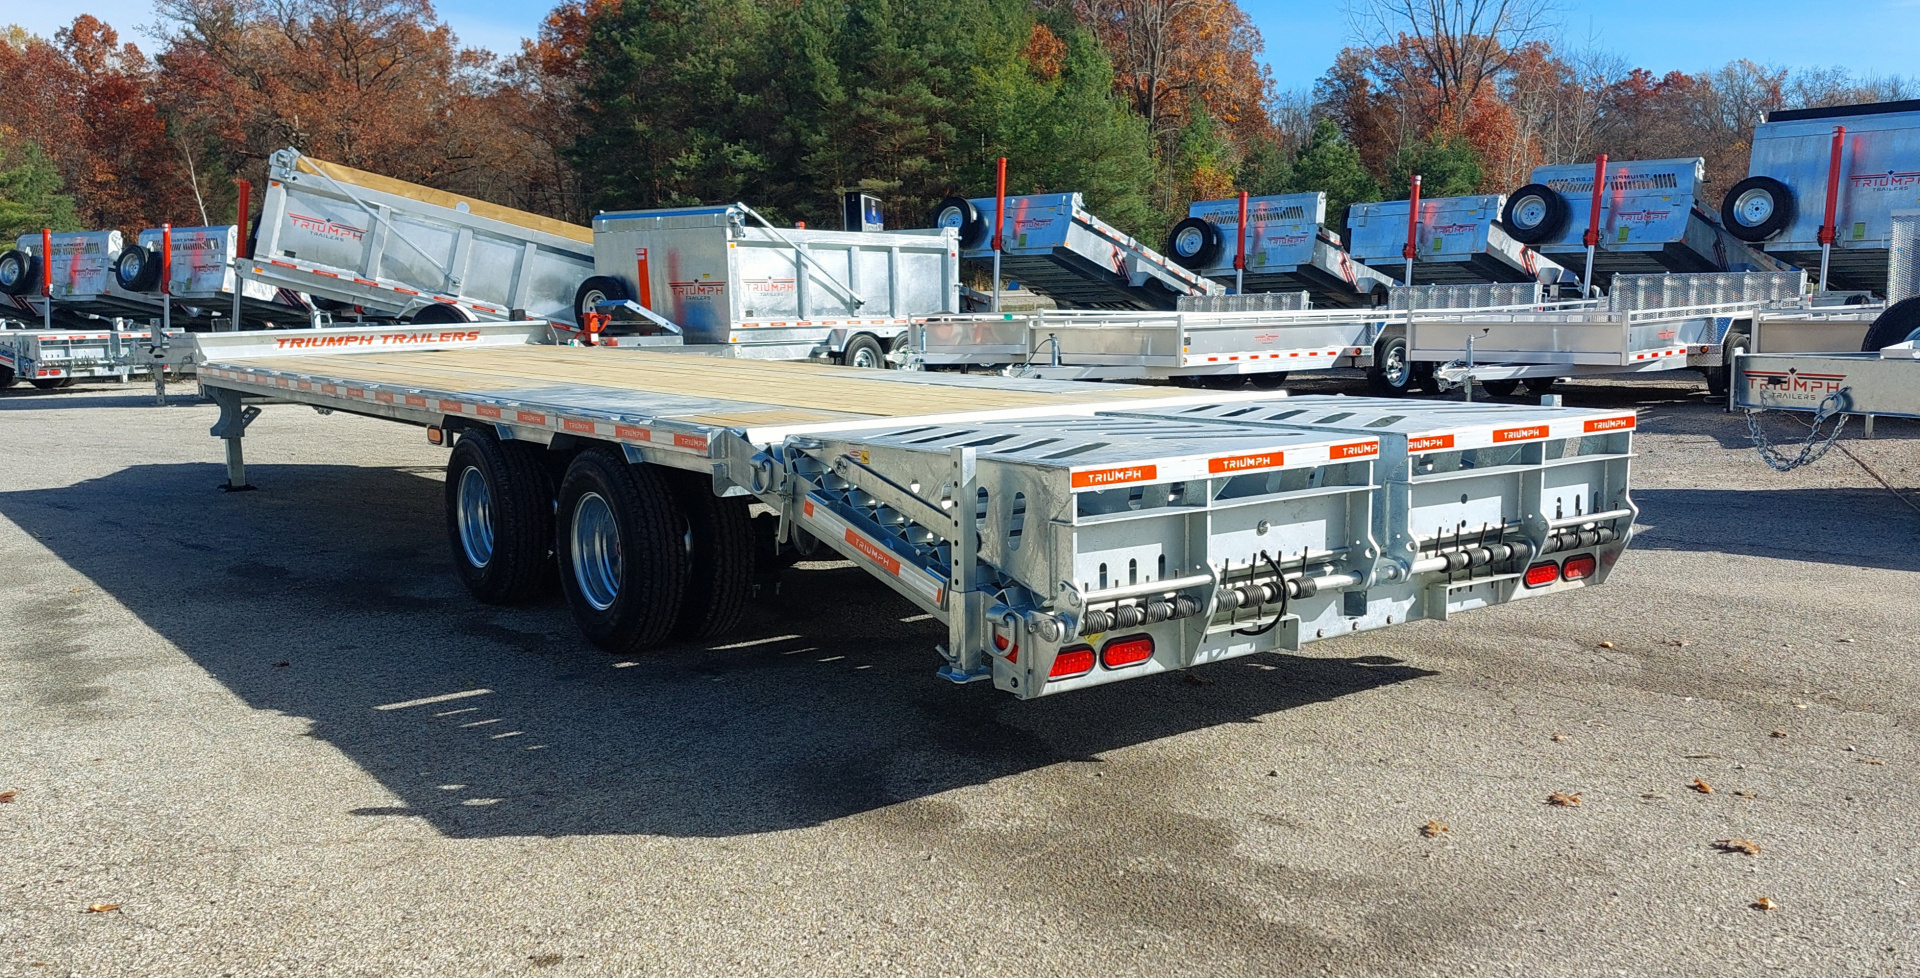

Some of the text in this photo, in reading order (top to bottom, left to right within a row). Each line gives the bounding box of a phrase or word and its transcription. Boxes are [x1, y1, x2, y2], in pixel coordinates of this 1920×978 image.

[1853, 177, 1920, 188] TRIUMP
[291, 218, 364, 241] TRIUMPH
[309, 230, 344, 242] TRAILERS
[671, 285, 724, 296] TRIUMPH
[745, 282, 795, 292] TRIUMPH
[275, 330, 481, 349] TRIUMPH TRAILERS
[1771, 392, 1817, 401] TRAILERS
[568, 421, 590, 432] TRIUMPH
[1593, 418, 1627, 430] TRIUMPH
[621, 428, 645, 440] TRIUMPH
[1503, 429, 1540, 440] TRIUMPH
[681, 436, 707, 449] TRIUMPH
[1408, 438, 1443, 451] RIUMPH
[1342, 444, 1378, 456] TRIUMP
[1222, 455, 1271, 470] TRIUMPH
[1087, 469, 1142, 483] TRIUMPH
[855, 538, 890, 567] TRIUMPH
